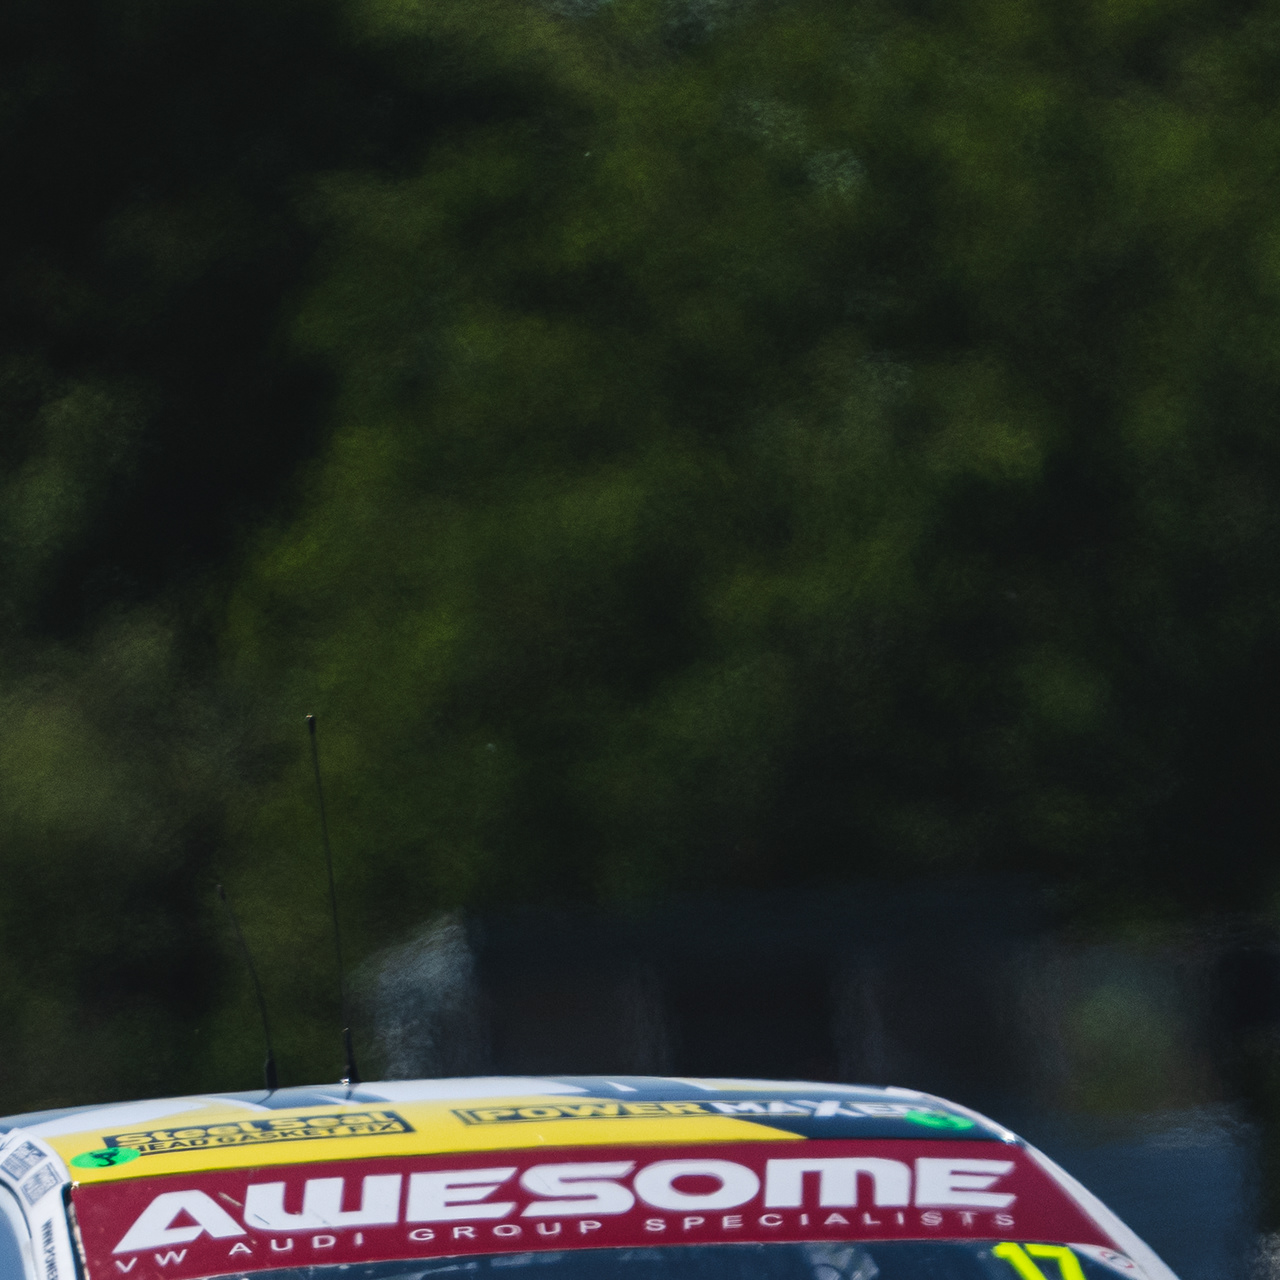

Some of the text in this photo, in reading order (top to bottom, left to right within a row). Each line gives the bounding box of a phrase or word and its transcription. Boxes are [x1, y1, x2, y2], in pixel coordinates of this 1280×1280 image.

[473, 1102, 710, 1122] POWER
[112, 1157, 1017, 1255] AWESOME
[115, 1212, 1016, 1274] VW AUDI GROUP SPECIALISTS
